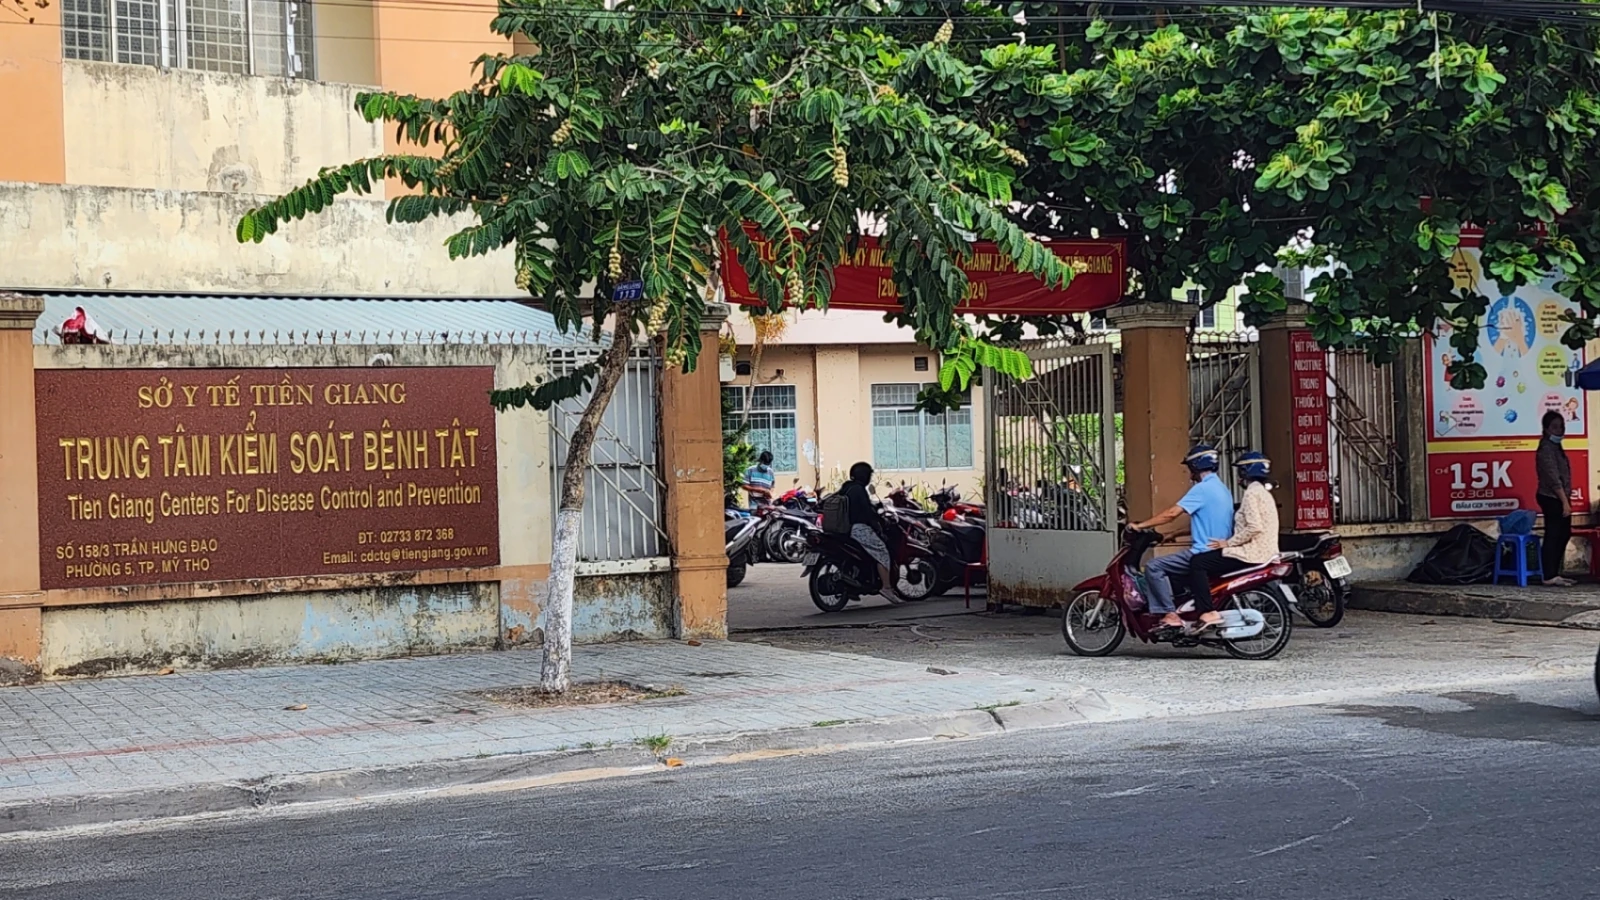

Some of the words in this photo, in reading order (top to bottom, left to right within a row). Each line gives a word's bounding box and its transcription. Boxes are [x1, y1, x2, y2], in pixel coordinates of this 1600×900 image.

[1088, 255, 1113, 274] GIANG
[619, 289, 636, 299] 113
[1294, 359, 1322, 371] NICOTINE
[138, 376, 174, 408] SỞ
[181, 385, 199, 407] Y
[206, 375, 241, 407] TẾ
[250, 372, 314, 406] TIỀN
[324, 382, 407, 405] GIANG
[1299, 377, 1319, 389] TRONG
[1294, 393, 1315, 408] THUỐC
[58, 434, 150, 480] TRUNG
[157, 423, 211, 477] TÂM
[220, 410, 278, 475] KIỂM
[290, 420, 354, 474] SOÁT
[363, 419, 429, 479] BỆNH
[435, 417, 479, 476] TẬT
[1300, 452, 1313, 464] CHO
[1450, 460, 1513, 490] 15K
[67, 494, 102, 520] Tien
[108, 492, 154, 524] Giang
[160, 490, 220, 517] Centers
[226, 488, 250, 513] For
[256, 487, 314, 512] Disease
[320, 484, 373, 510] Control
[377, 483, 403, 508] and
[407, 481, 481, 506] Prevention
[1468, 489, 1494, 498] 3GB
[358, 531, 377, 544] ĐT:
[380, 530, 412, 544] 02733
[414, 529, 433, 541] 872
[436, 528, 454, 541] 368
[56, 540, 74, 560] SỐ
[78, 543, 109, 558] 158/3
[113, 537, 148, 556] TRẦN
[152, 539, 187, 555] HƯNG
[191, 538, 218, 555] ĐẠO
[323, 551, 357, 565] Email:
[360, 545, 489, 564] cdctg@tiengiang.gov.vn
[66, 558, 121, 578] PHƯỜNG
[124, 562, 135, 576] 5,
[138, 561, 158, 574] TP.
[162, 557, 179, 573] MỸ
[184, 558, 210, 572] THO
